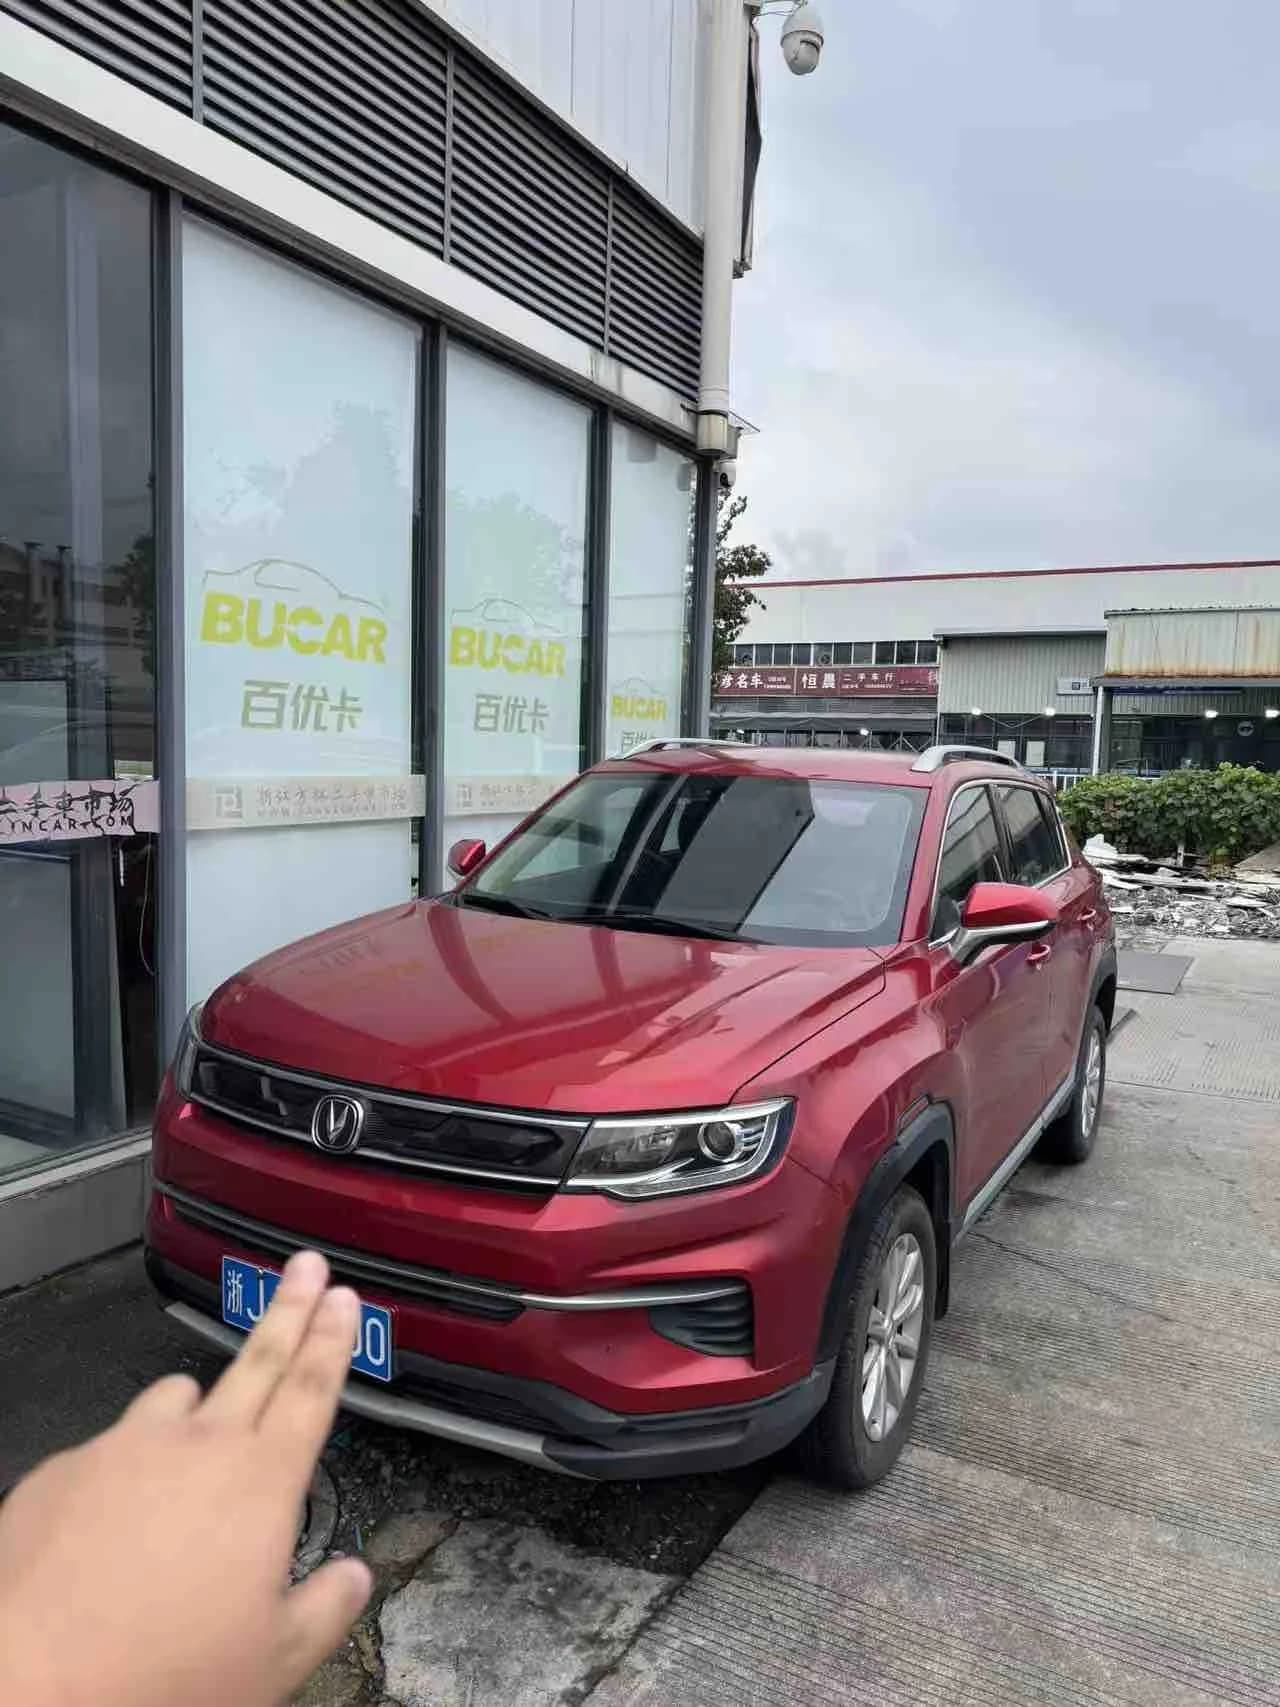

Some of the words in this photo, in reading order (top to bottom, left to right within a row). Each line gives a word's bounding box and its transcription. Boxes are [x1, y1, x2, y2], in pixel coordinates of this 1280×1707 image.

[200, 591, 388, 664] BUCAR
[451, 627, 566, 675] BUCAR
[241, 679, 363, 732] 百优卡
[473, 693, 549, 734] 百优卡
[611, 695, 667, 720] BUCAR
